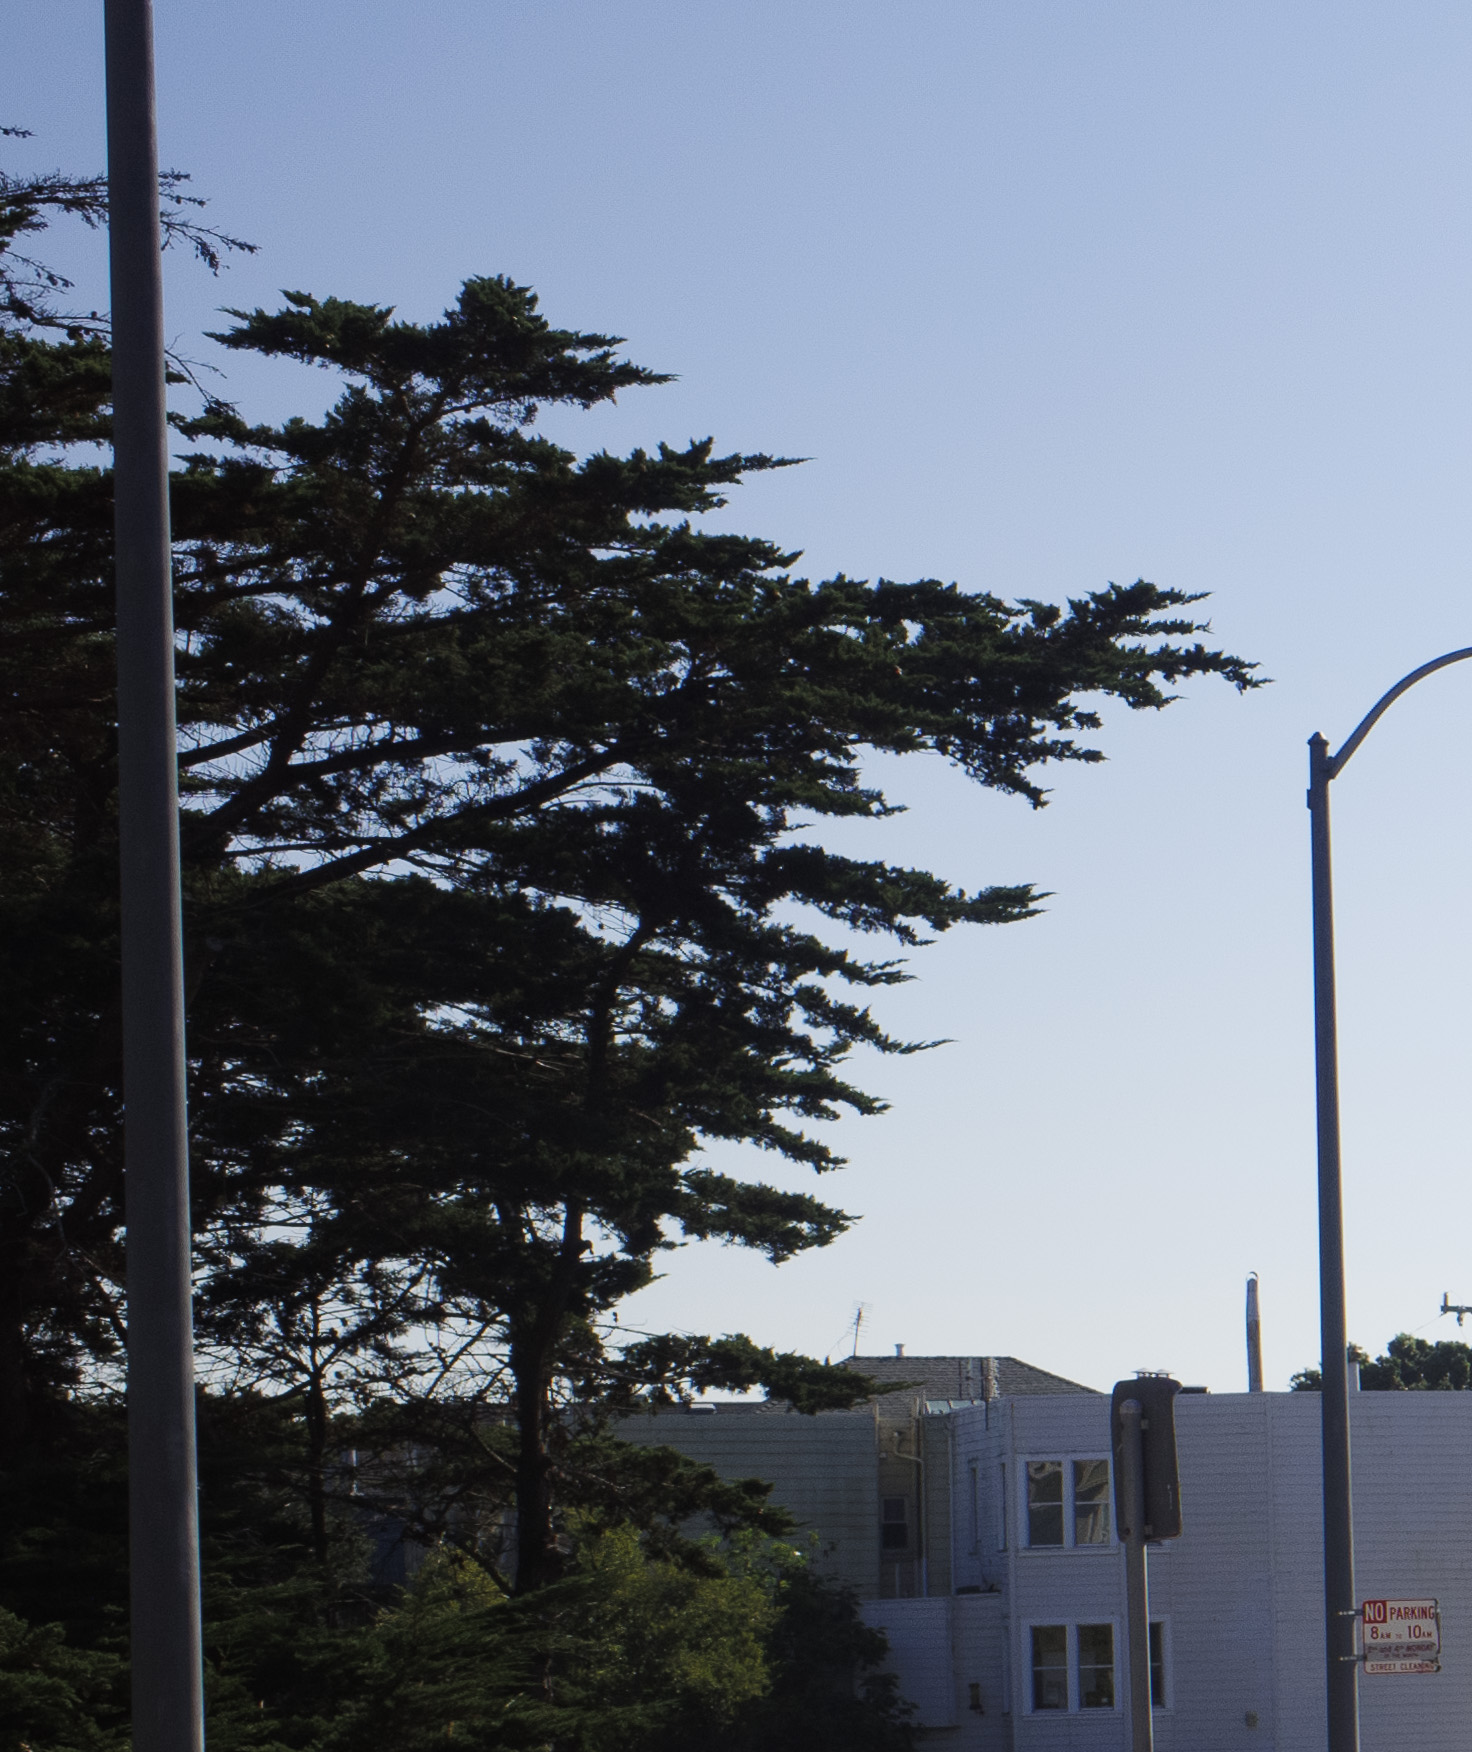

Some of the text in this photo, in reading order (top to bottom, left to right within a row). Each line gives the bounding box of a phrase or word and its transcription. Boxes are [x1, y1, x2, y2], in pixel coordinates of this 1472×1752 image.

[1365, 1602, 1435, 1621] NO PARKING
[1370, 1663, 1396, 1671] STREET
